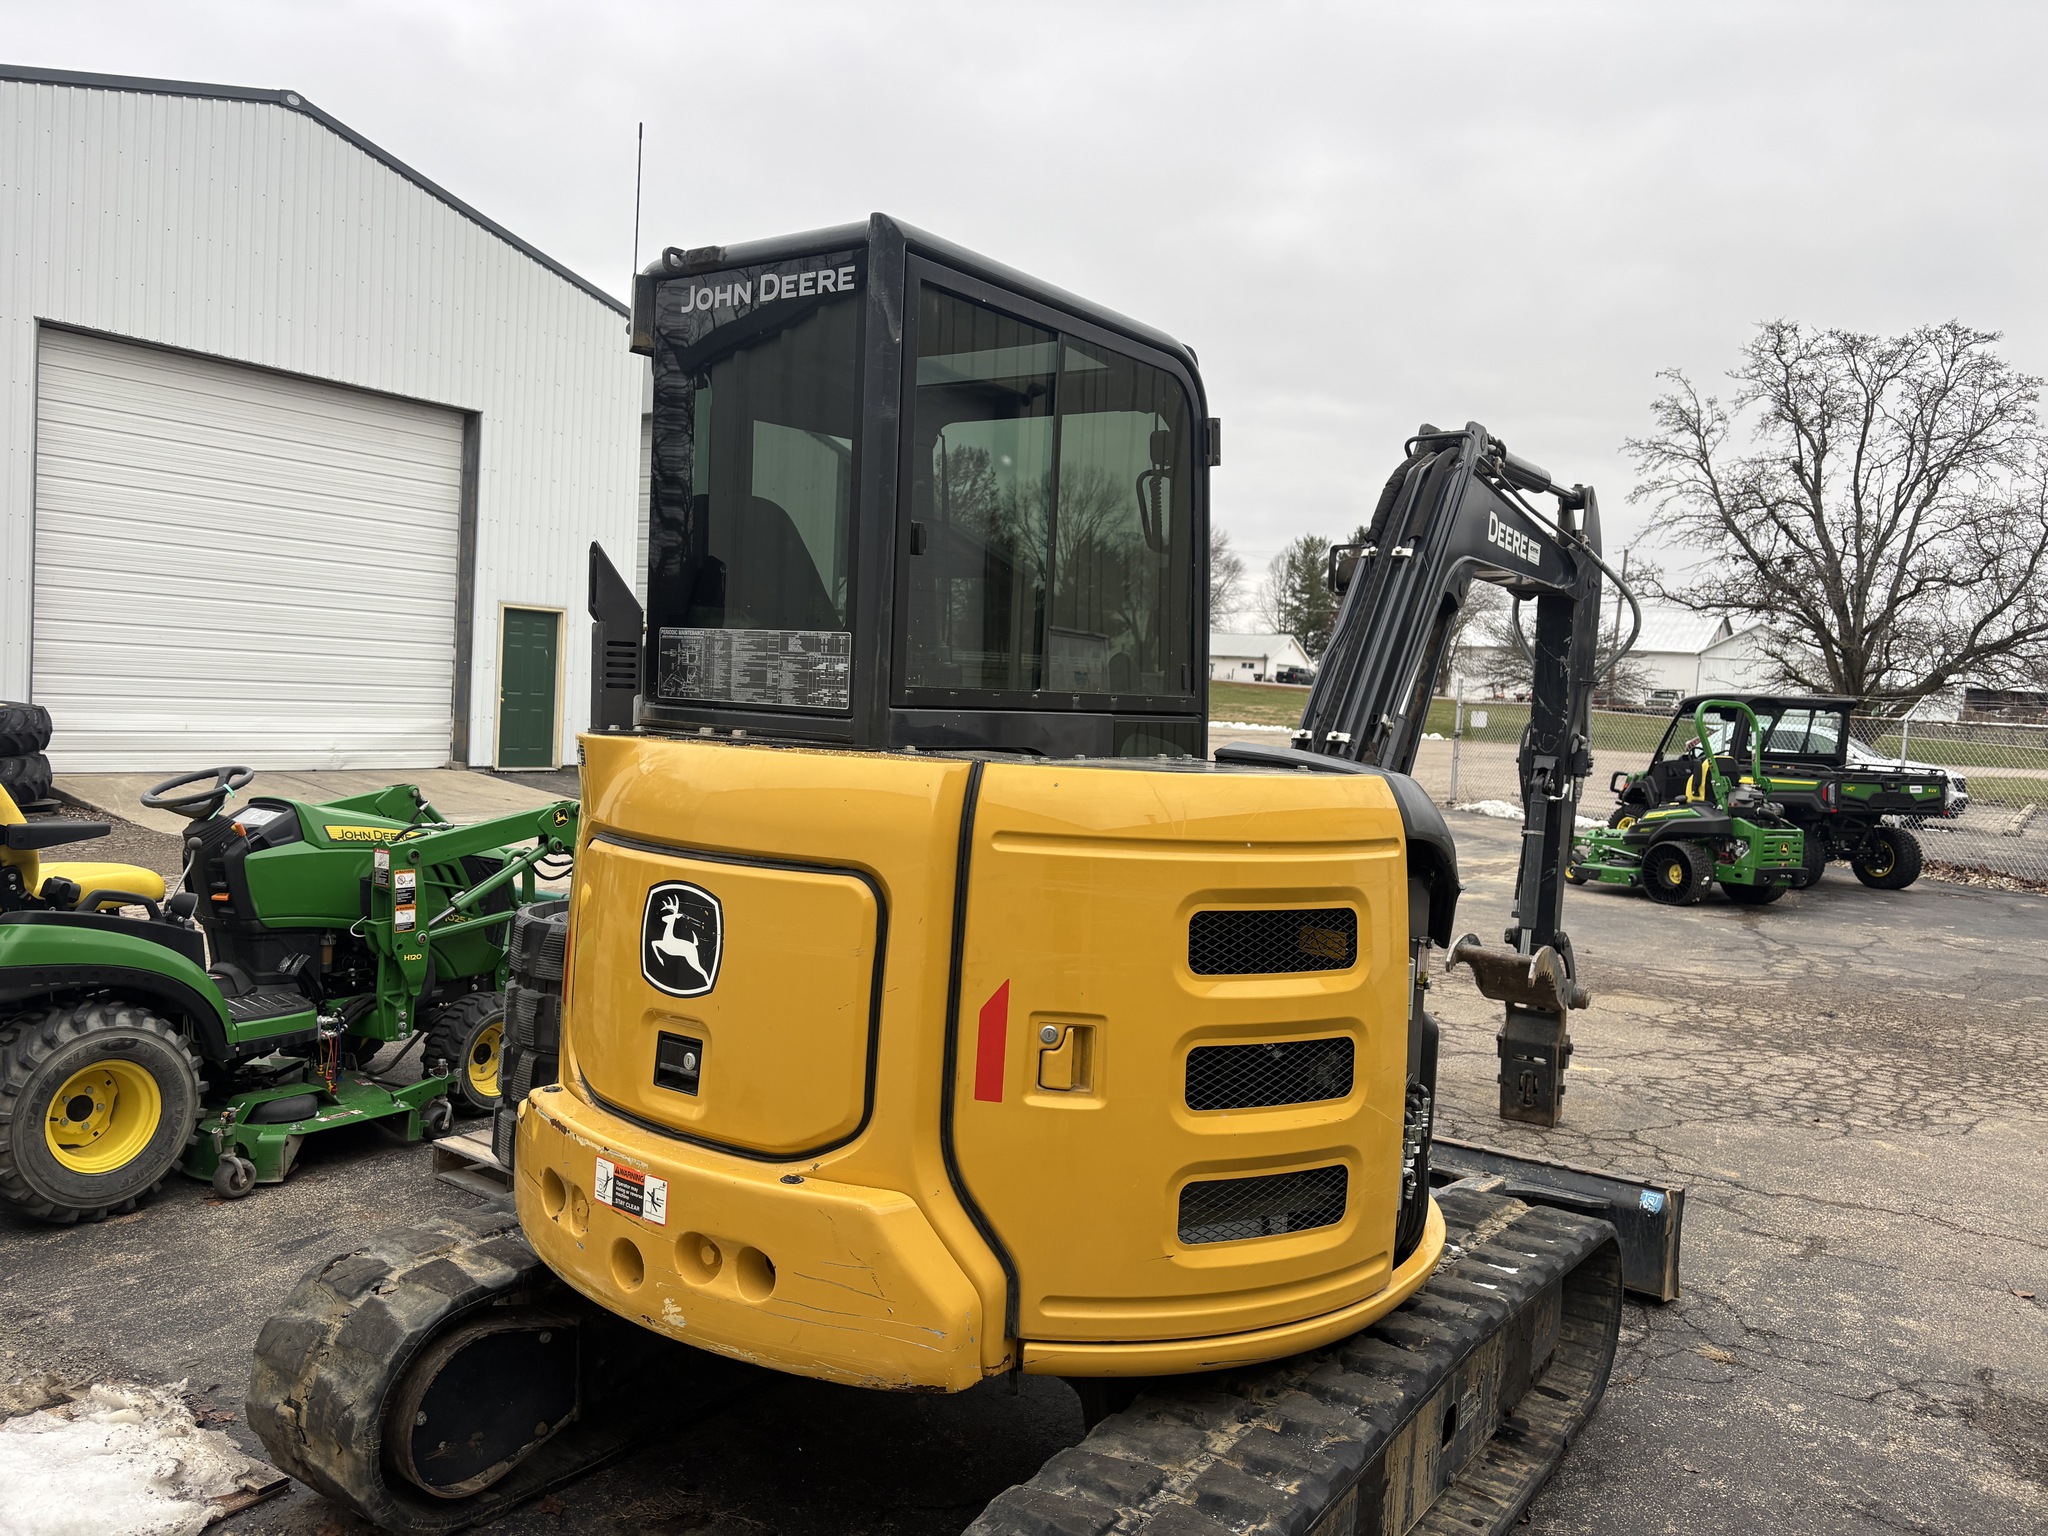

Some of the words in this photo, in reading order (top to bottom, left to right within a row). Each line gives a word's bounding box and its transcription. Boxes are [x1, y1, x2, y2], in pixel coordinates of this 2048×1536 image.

[681, 281, 752, 313] JOHN
[759, 265, 856, 302] DEERE
[1487, 510, 1529, 560] DEERE
[338, 829, 371, 840] JOHN
[403, 953, 423, 961] H120
[620, 1168, 644, 1182] WARNING
[616, 1180, 630, 1189] Operator
[616, 1198, 625, 1206] STAY
[626, 1202, 640, 1211] CLEAR
